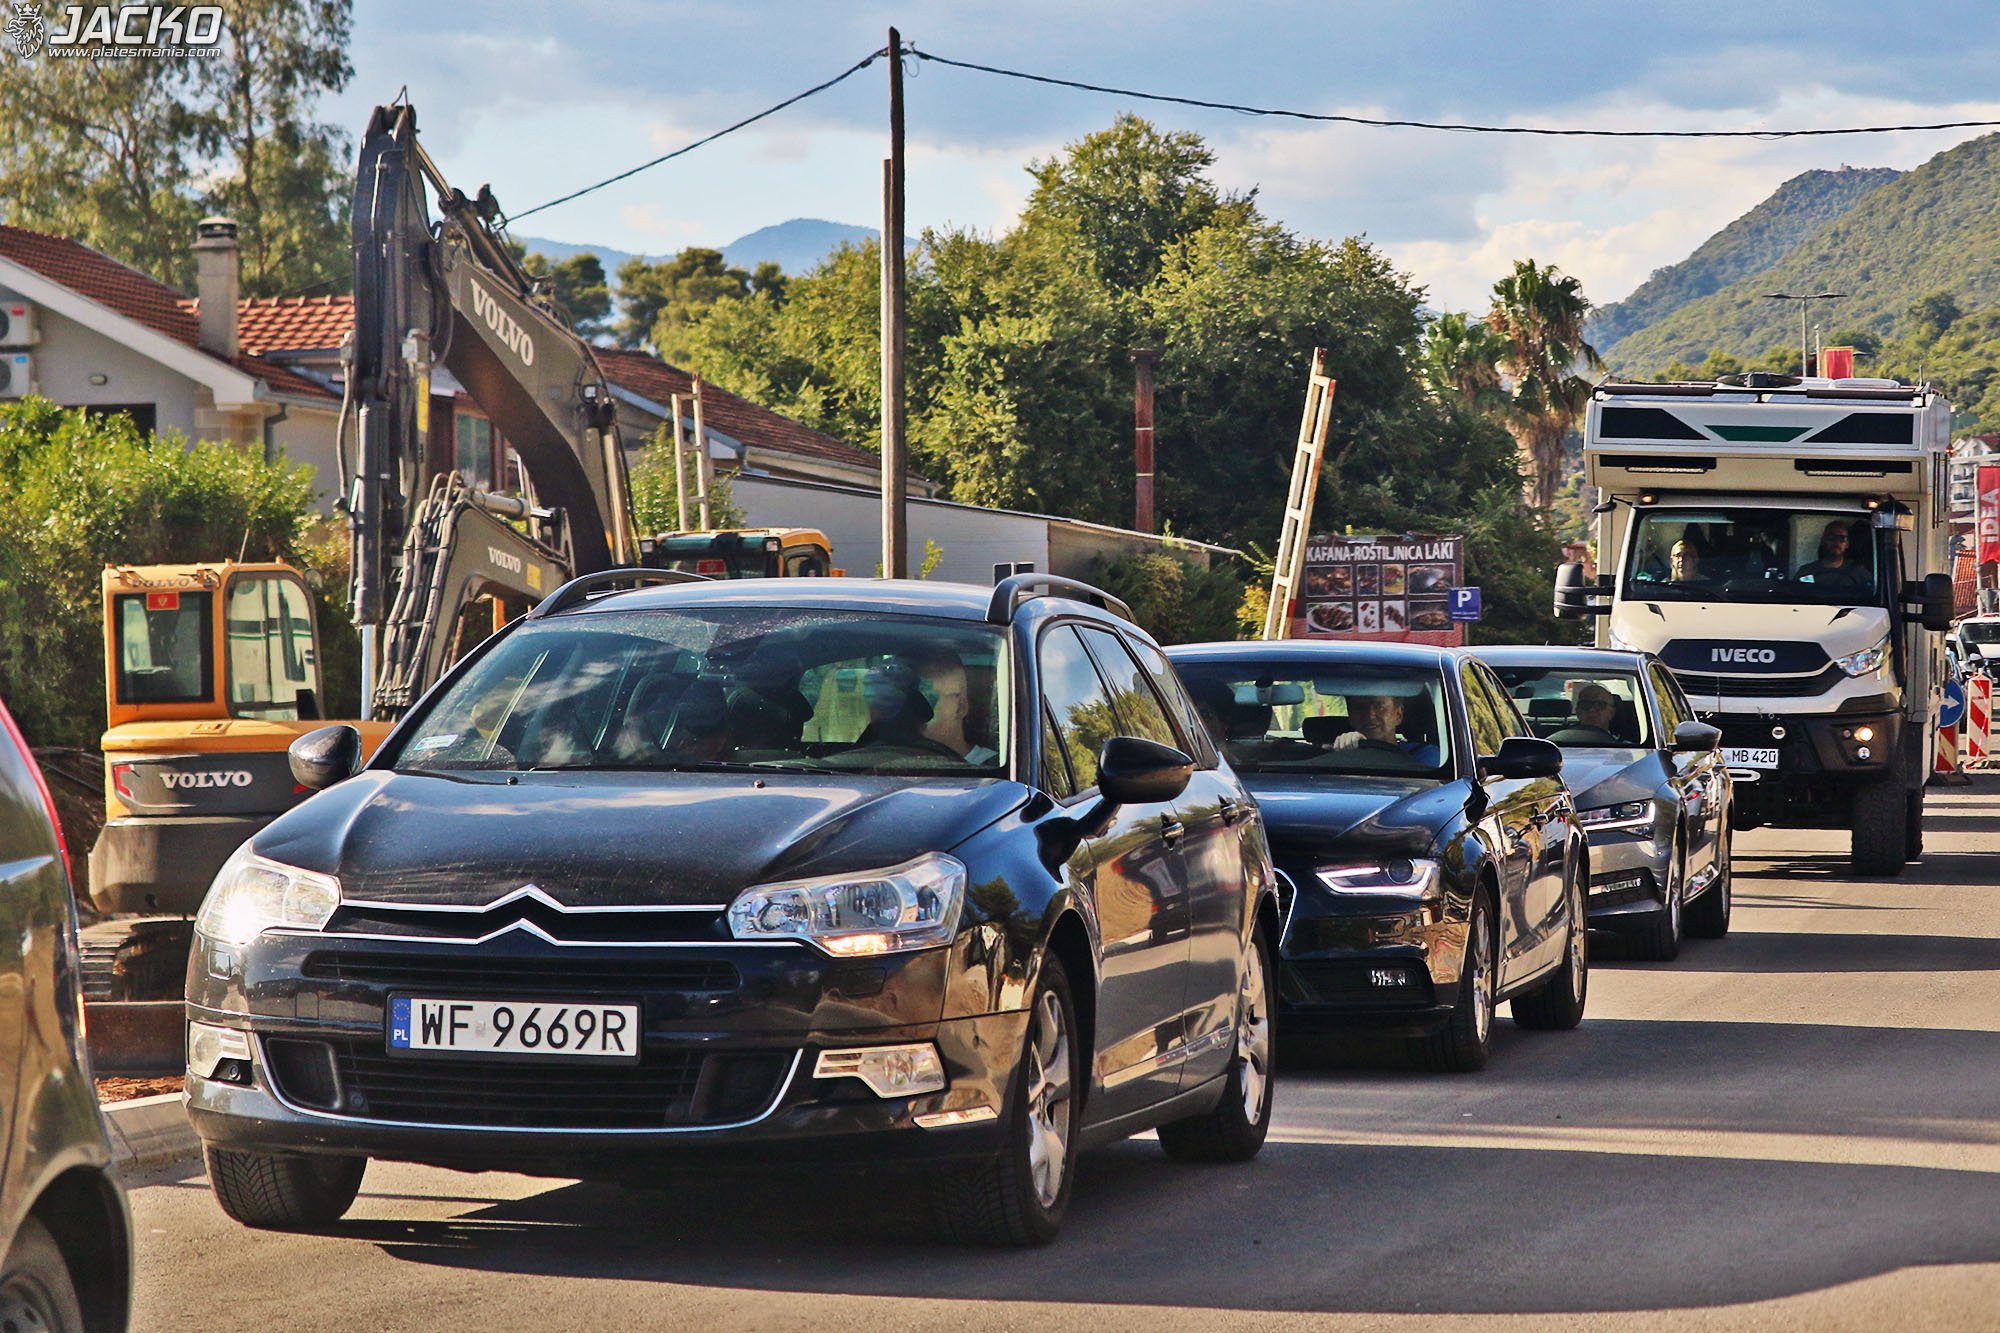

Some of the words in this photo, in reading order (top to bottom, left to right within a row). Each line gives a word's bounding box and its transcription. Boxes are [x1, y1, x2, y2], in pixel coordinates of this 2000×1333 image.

[470, 277, 534, 367] VOLVO
[1425, 542, 1454, 559] LAKI
[487, 546, 521, 574] VOLVO
[1457, 590, 1472, 608] P
[1711, 648, 1776, 664] IVECO
[1732, 750, 1749, 763] MB
[1752, 750, 1777, 764] 420
[159, 770, 253, 789] VOLVO
[393, 1029, 408, 1041] PL
[421, 1003, 474, 1046] WF
[492, 1006, 627, 1052] 9669R
